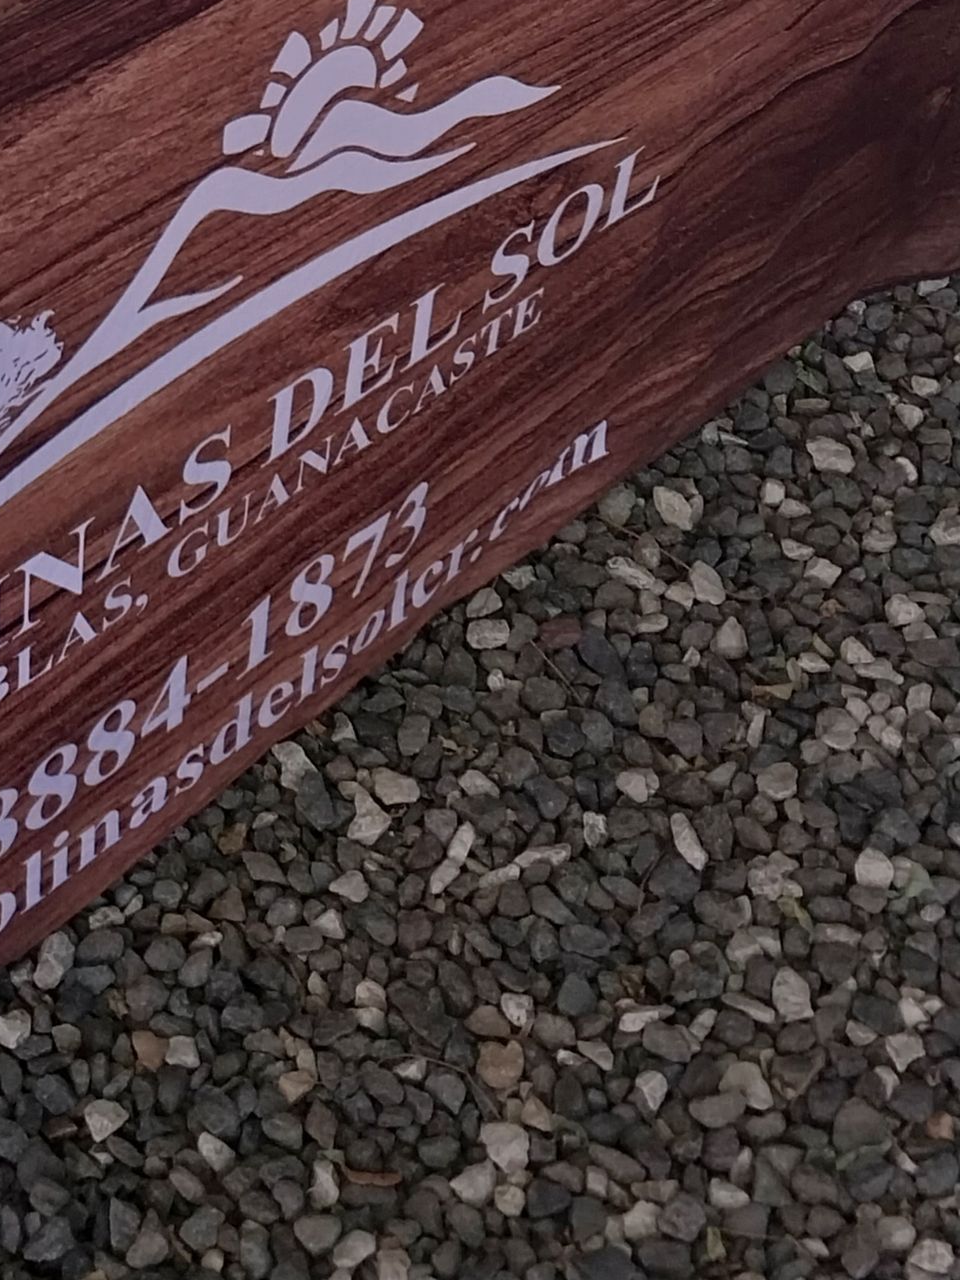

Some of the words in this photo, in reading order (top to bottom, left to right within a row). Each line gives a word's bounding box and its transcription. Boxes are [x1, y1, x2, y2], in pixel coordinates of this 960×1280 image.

[167, 287, 545, 578] GUANACASTE
[260, 283, 463, 468] DEL
[482, 145, 660, 310] SOL
